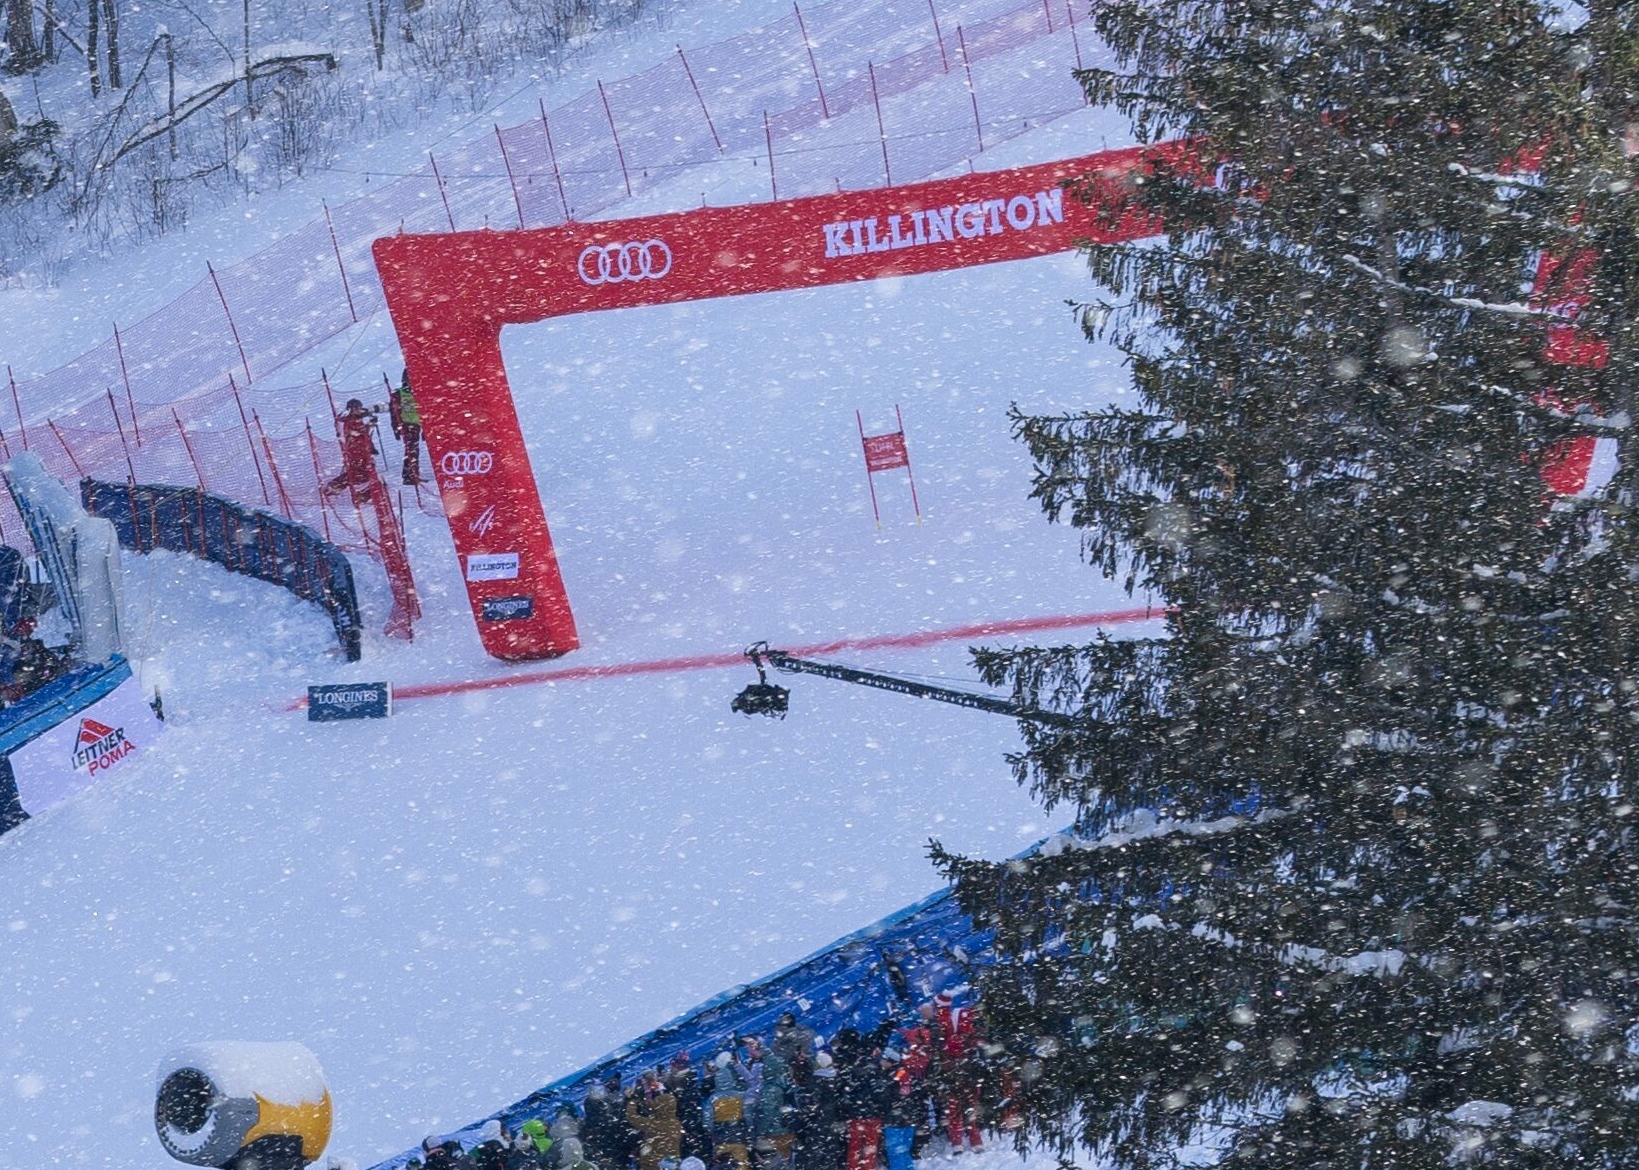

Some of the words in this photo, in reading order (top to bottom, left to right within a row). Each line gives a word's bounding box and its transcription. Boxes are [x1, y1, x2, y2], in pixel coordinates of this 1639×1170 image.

[823, 188, 1064, 259] KILLINGTON
[315, 688, 379, 705] LONGINES
[71, 726, 126, 771] LEITNER
[88, 740, 136, 777] POMA
